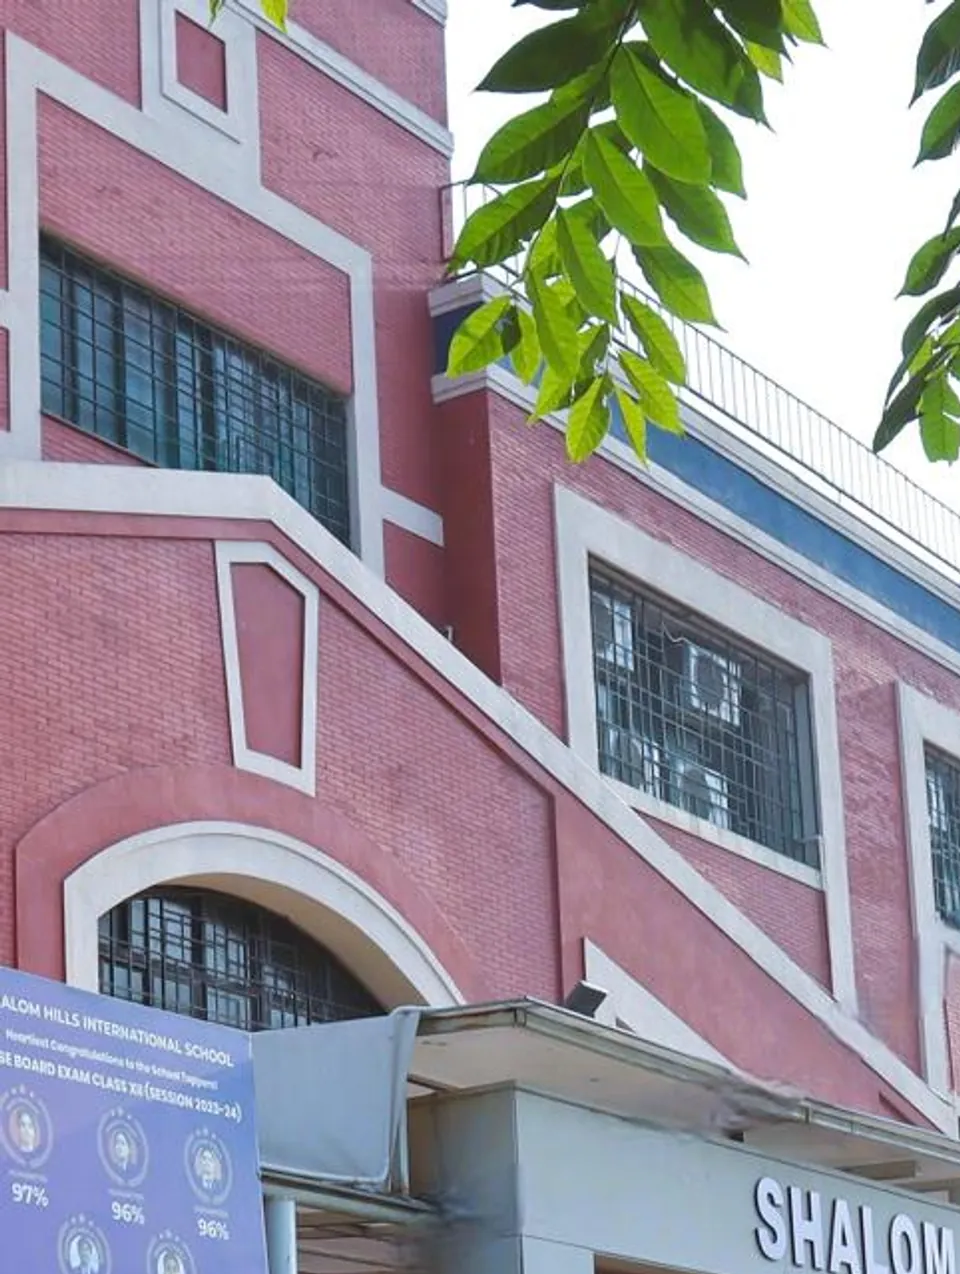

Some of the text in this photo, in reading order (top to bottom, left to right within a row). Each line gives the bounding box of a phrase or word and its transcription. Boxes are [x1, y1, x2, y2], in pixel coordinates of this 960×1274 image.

[43, 1005, 80, 1028] HILLS
[82, 1016, 182, 1055] INTERNATIONAL
[184, 1041, 235, 1068] SCHOOL
[13, 1053, 56, 1077] BOARD
[57, 1063, 91, 1086] EXAM
[91, 1072, 127, 1093] CLASS
[11, 1182, 50, 1207] 97%
[111, 1201, 146, 1225] 96%
[197, 1217, 231, 1241] 96%
